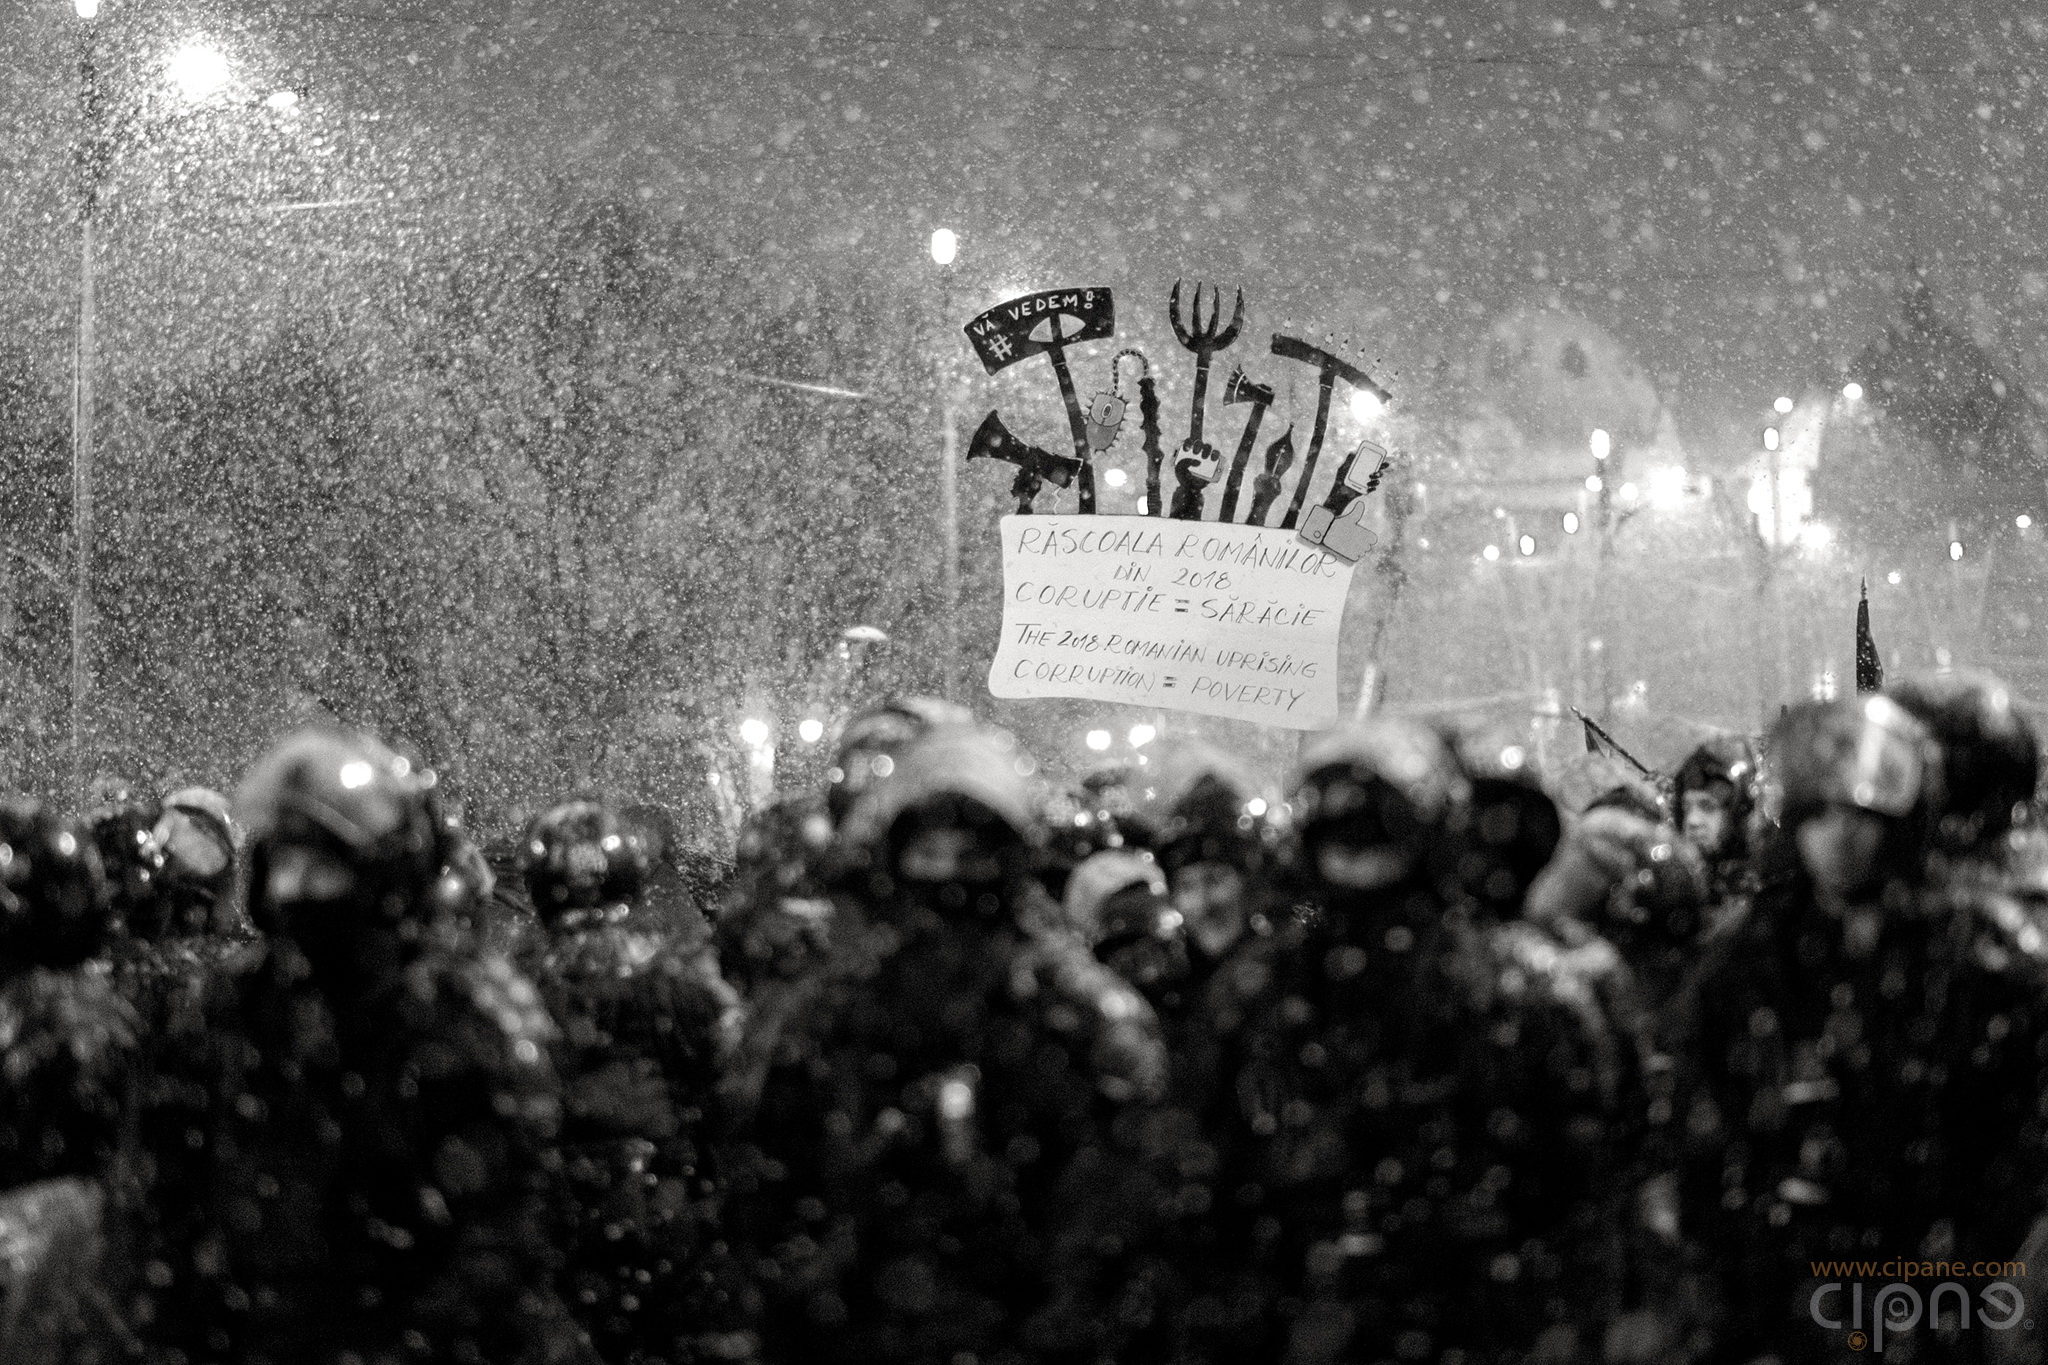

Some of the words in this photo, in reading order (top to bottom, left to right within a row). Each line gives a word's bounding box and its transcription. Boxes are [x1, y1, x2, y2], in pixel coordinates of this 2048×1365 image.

[1007, 290, 1096, 321] VEDEM!
[1017, 522, 1163, 557] RĂSCOALA
[1174, 533, 1338, 578] ROMÂNILOR
[1171, 567, 1232, 590] 2018
[1201, 593, 1325, 627] SĂRĂCIE
[1015, 623, 1056, 647] THE
[1057, 630, 1100, 653] 2018
[1103, 634, 1207, 663] ROMANIAN
[1216, 650, 1319, 679] UPRISING
[1014, 659, 1156, 692] CORRUPTION
[1191, 676, 1305, 711] POVERTY
